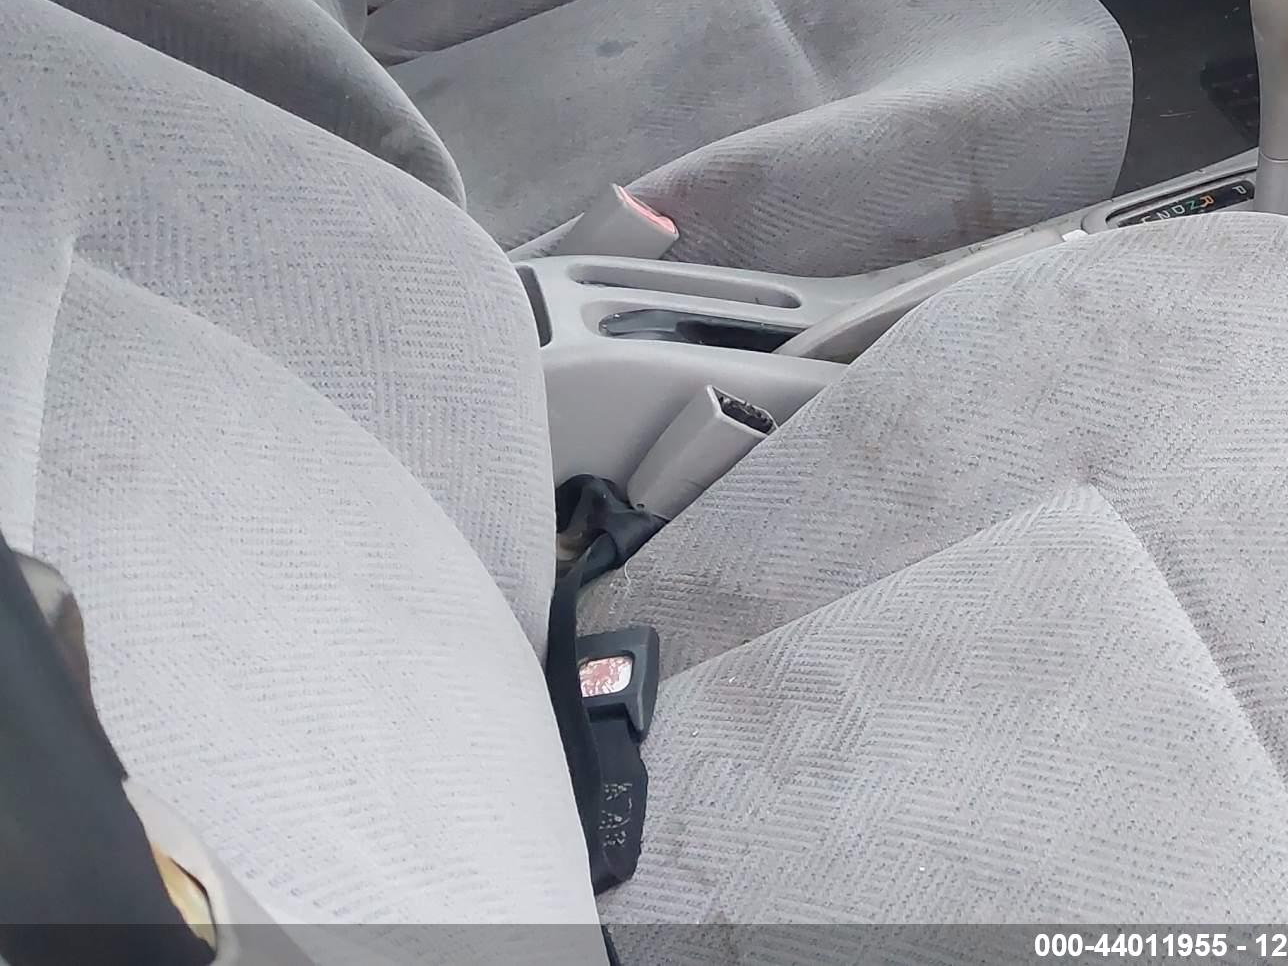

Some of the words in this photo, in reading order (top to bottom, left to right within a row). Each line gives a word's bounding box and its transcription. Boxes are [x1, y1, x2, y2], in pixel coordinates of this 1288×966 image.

[1231, 185, 1247, 196] P
[1199, 195, 1215, 209] R
[1171, 204, 1185, 215] D
